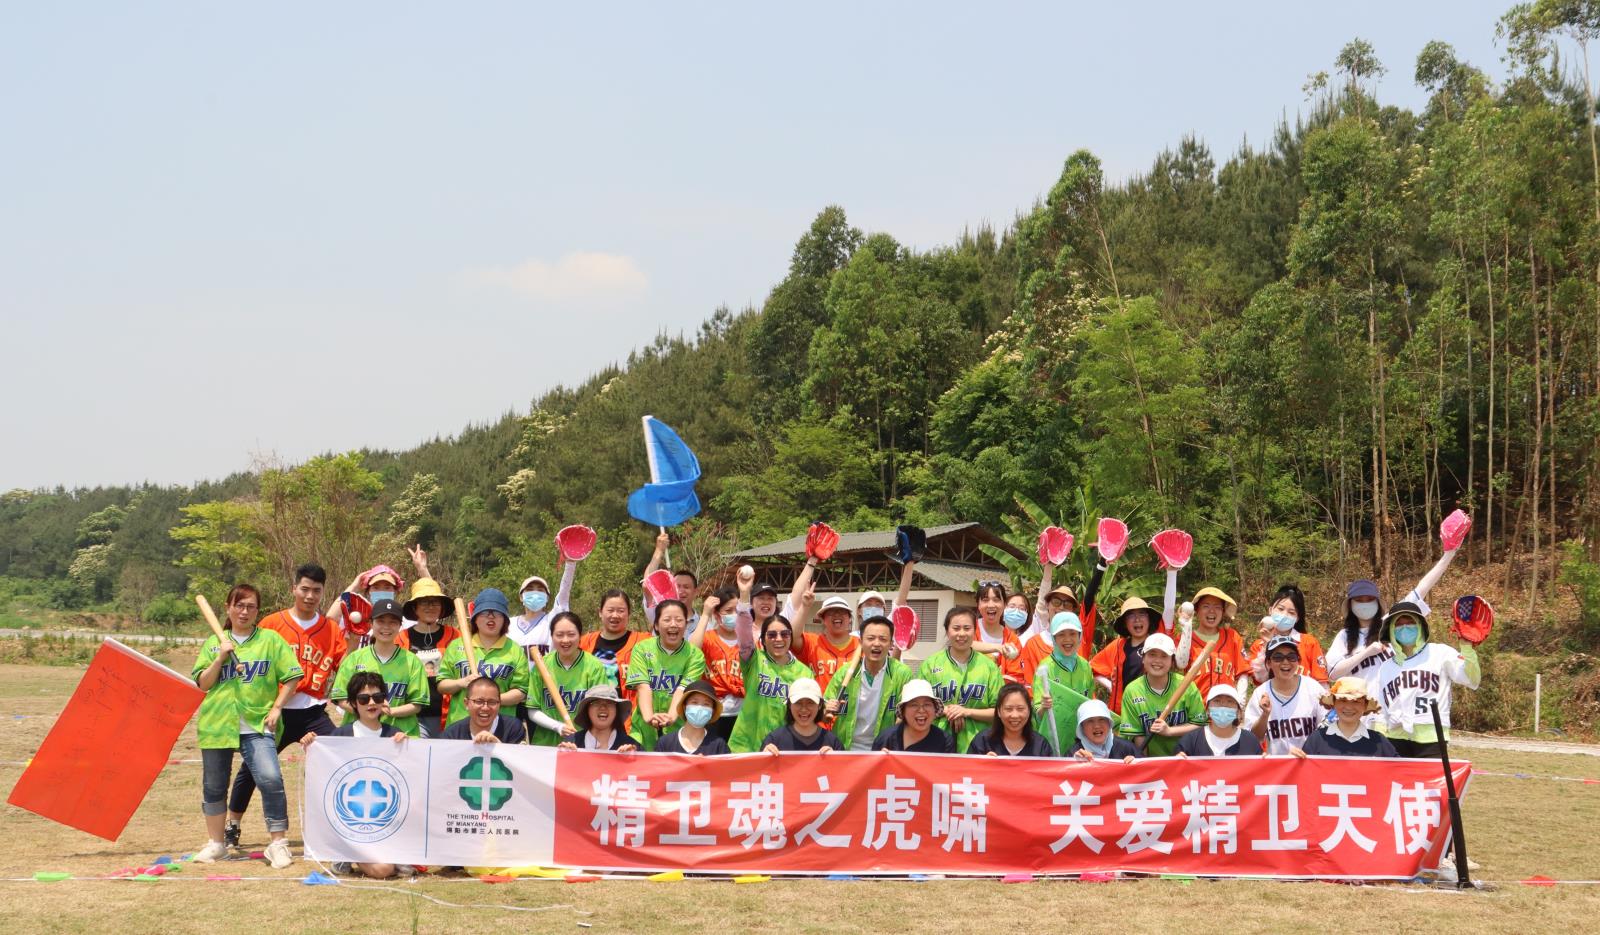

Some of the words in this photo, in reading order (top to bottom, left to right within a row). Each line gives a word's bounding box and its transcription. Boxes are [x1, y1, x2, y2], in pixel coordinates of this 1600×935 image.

[290, 643, 333, 671] TROS
[218, 659, 272, 684] okyo
[647, 668, 684, 695] Toky
[757, 674, 790, 704] Toky
[590, 774, 990, 853] 精卫魂之虎啸
[1048, 779, 1441, 855] 关爱精卫天使
